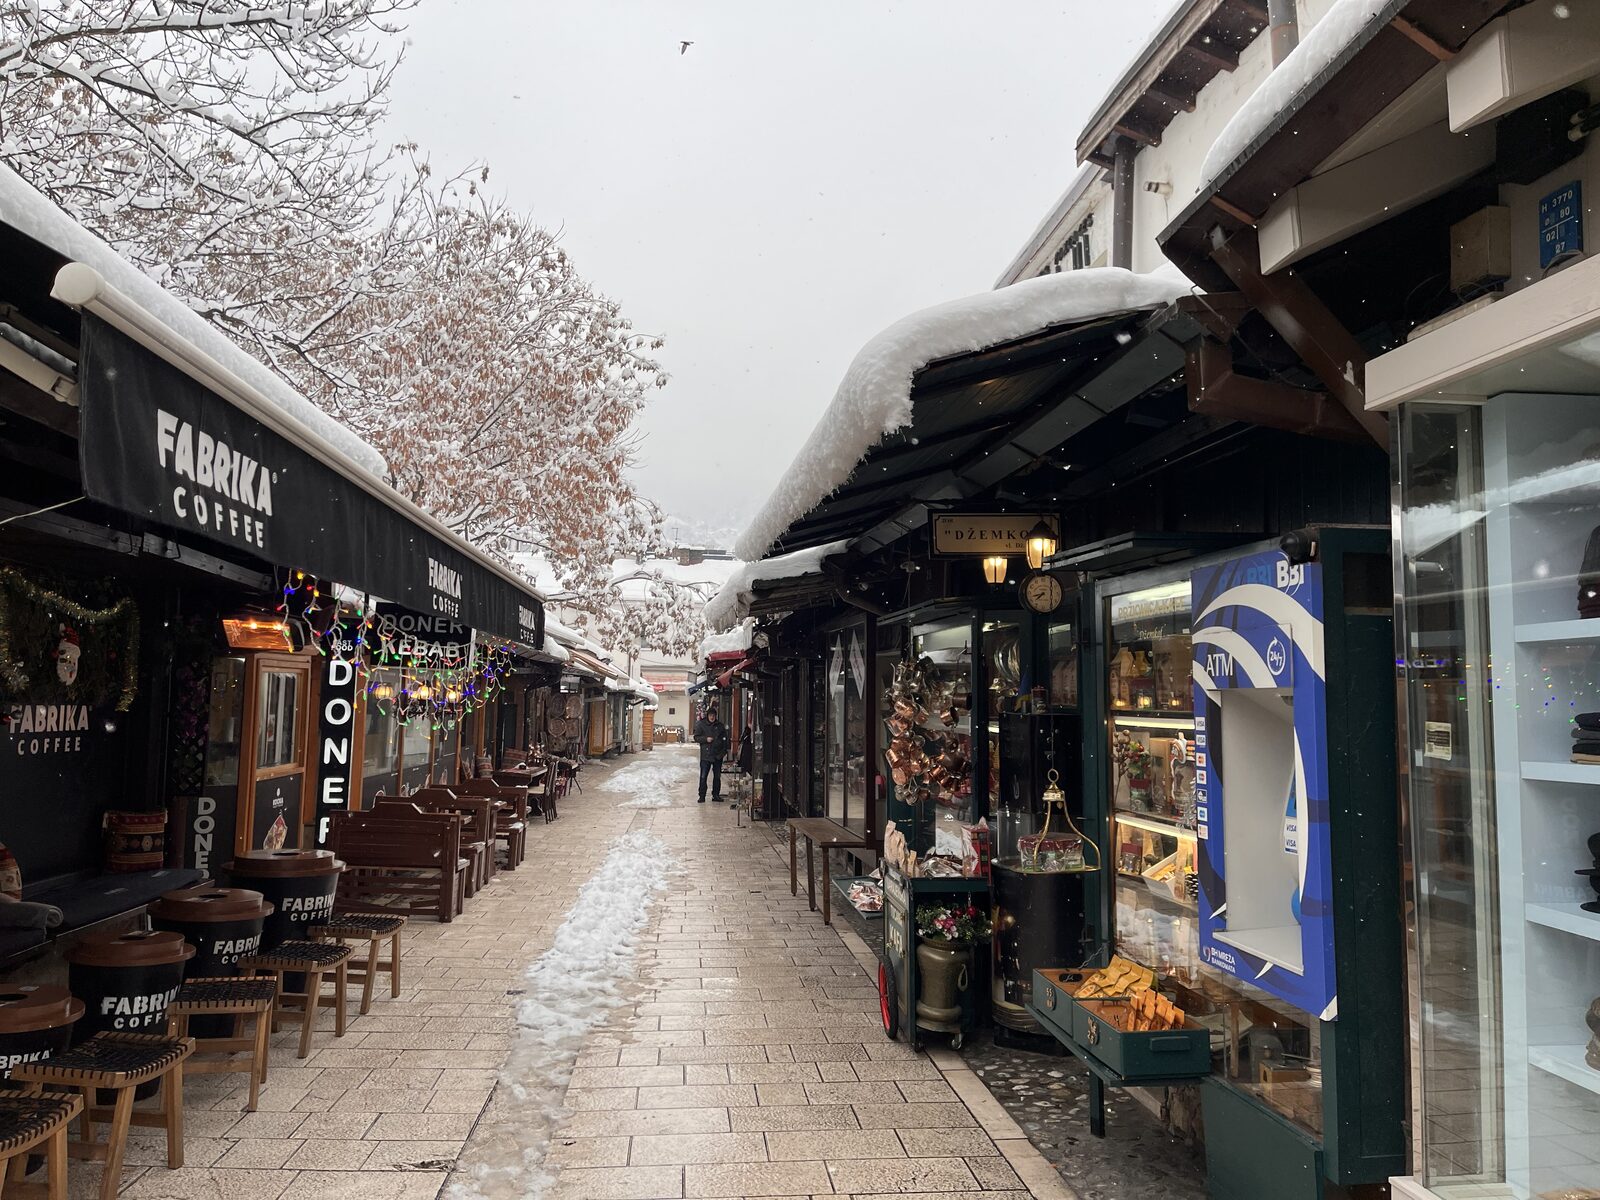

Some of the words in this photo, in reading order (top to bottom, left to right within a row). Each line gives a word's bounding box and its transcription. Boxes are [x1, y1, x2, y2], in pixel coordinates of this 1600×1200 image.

[1552, 190, 1573, 208] 3770
[157, 408, 273, 517] FABRIKA
[173, 486, 265, 549] COFFEE
[428, 557, 462, 600] FABRIKA
[1276, 560, 1305, 588] BBI
[432, 594, 459, 618] COFFEE
[383, 614, 463, 634] DONER
[381, 638, 460, 658] KEBAB
[1206, 653, 1233, 677] ATM
[9, 704, 89, 734] FABRIKA
[17, 736, 81, 756] COFFEE
